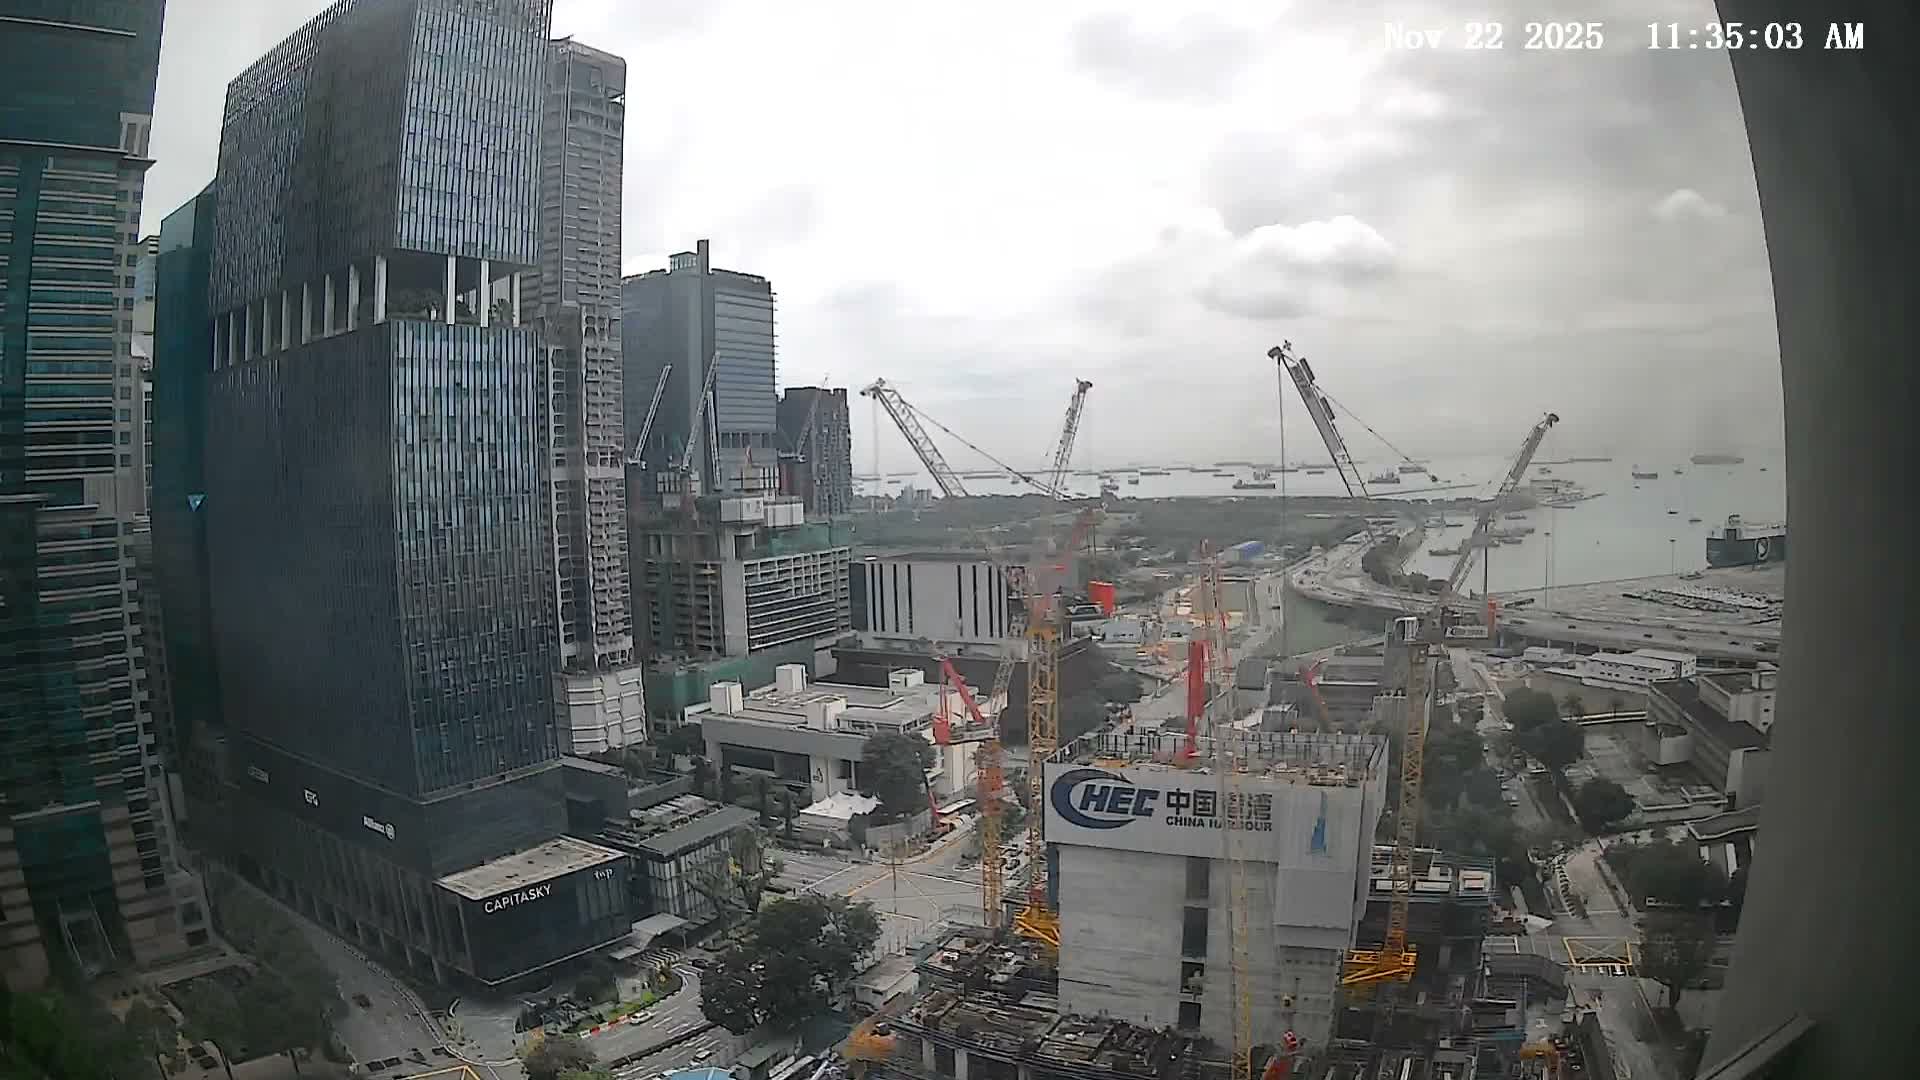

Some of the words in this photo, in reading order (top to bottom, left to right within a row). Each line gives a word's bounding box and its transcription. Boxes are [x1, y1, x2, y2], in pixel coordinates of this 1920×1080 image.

[1166, 816, 1205, 828] CHINA
[1209, 819, 1273, 832] HOUR
[484, 884, 552, 913] CAPITASKY
